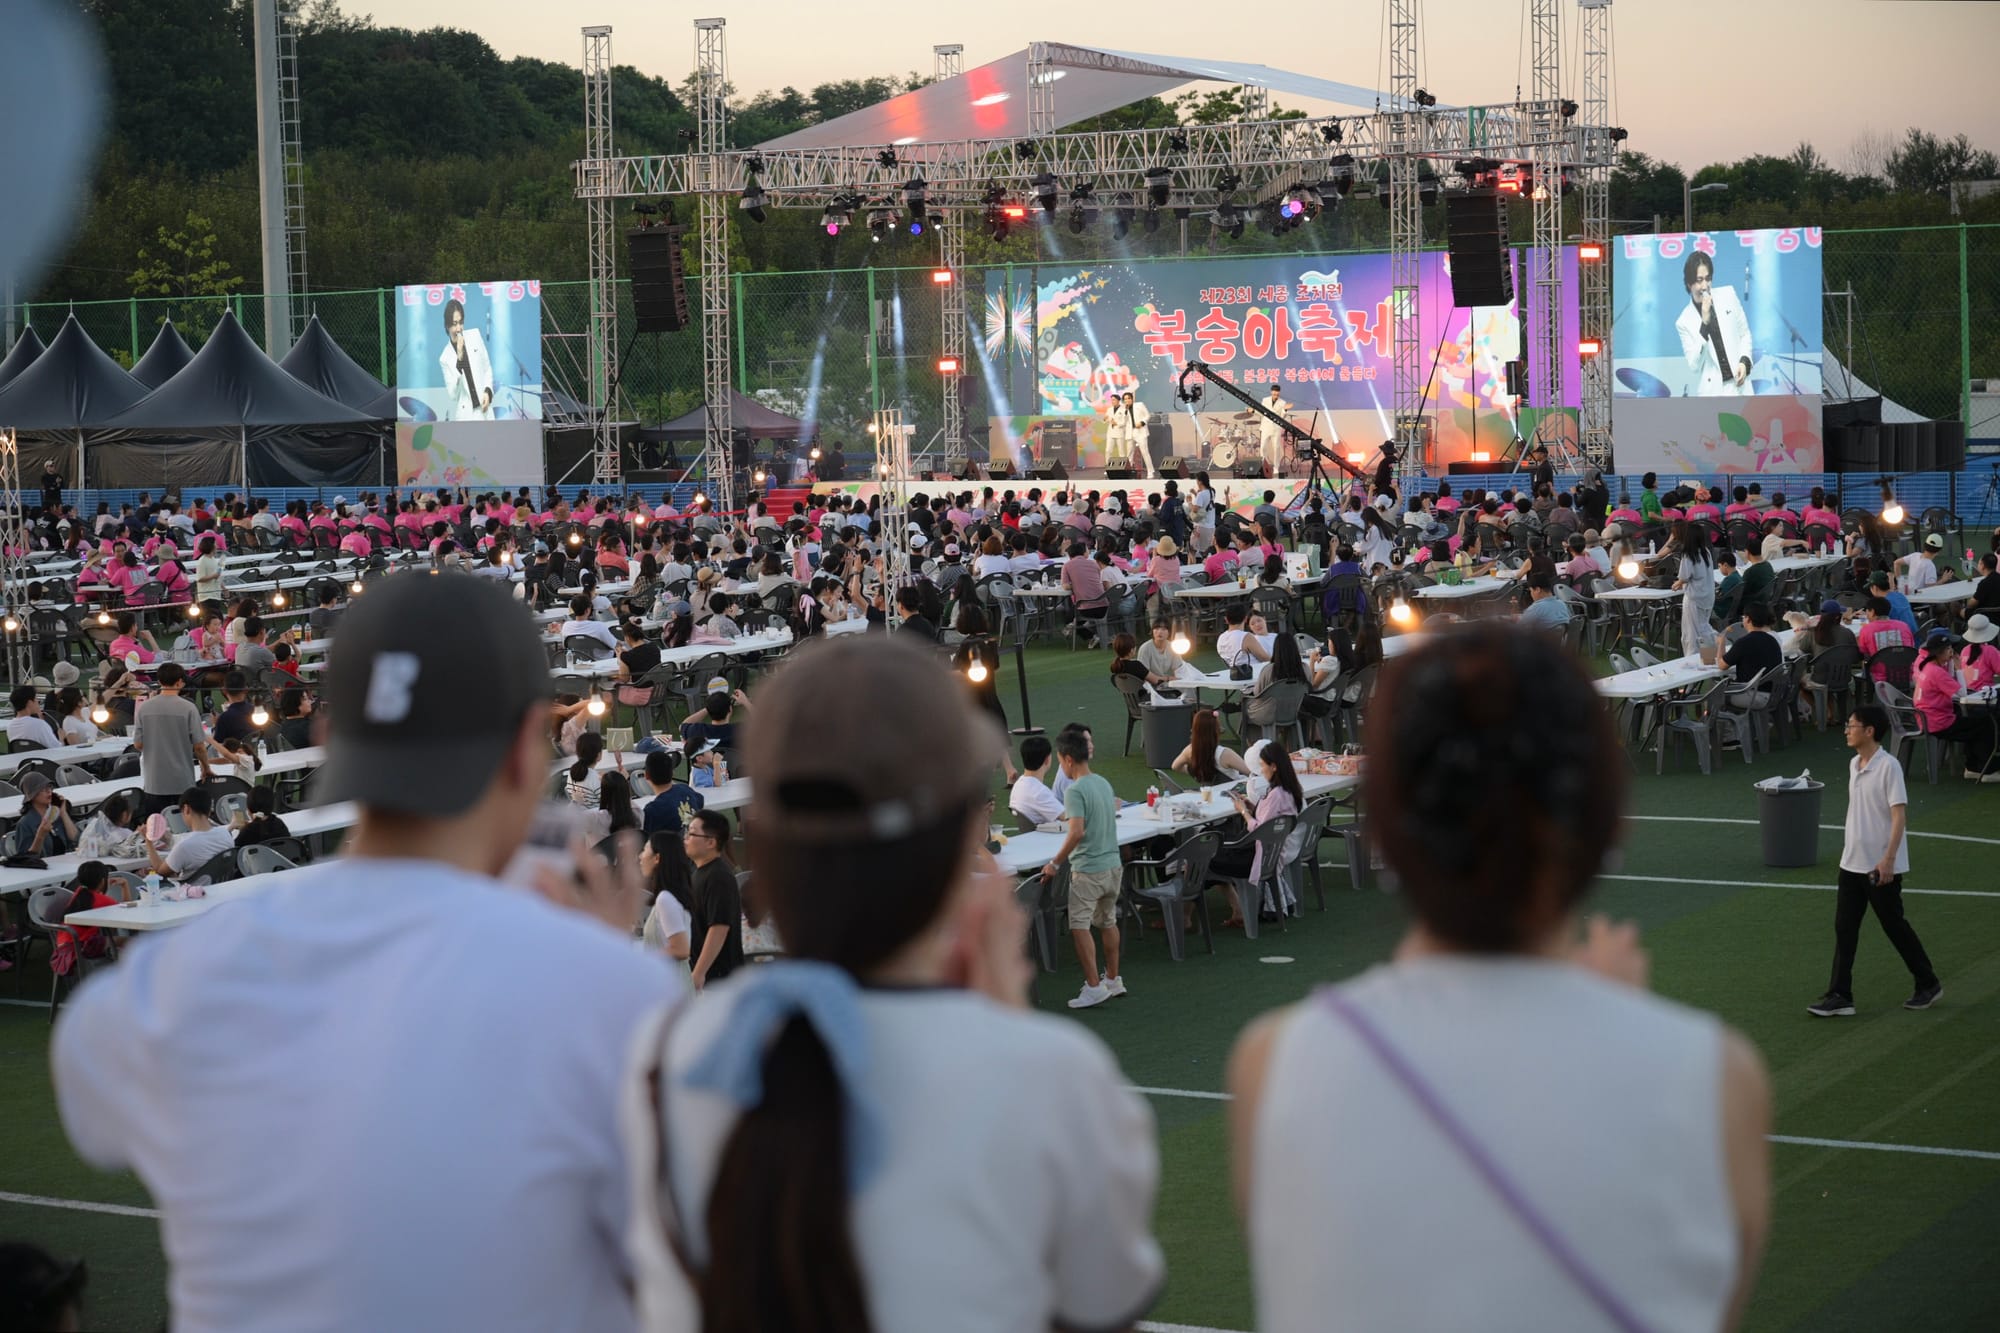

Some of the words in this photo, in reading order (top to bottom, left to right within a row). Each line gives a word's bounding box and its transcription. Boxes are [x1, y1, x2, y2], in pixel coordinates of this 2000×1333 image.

[1200, 286, 1252, 305] 제23회
[1257, 284, 1288, 302] 세종
[1295, 282, 1342, 302] 조치원
[1143, 302, 1394, 365] 복숭아축제
[1284, 367, 1335, 382] 복숭아에
